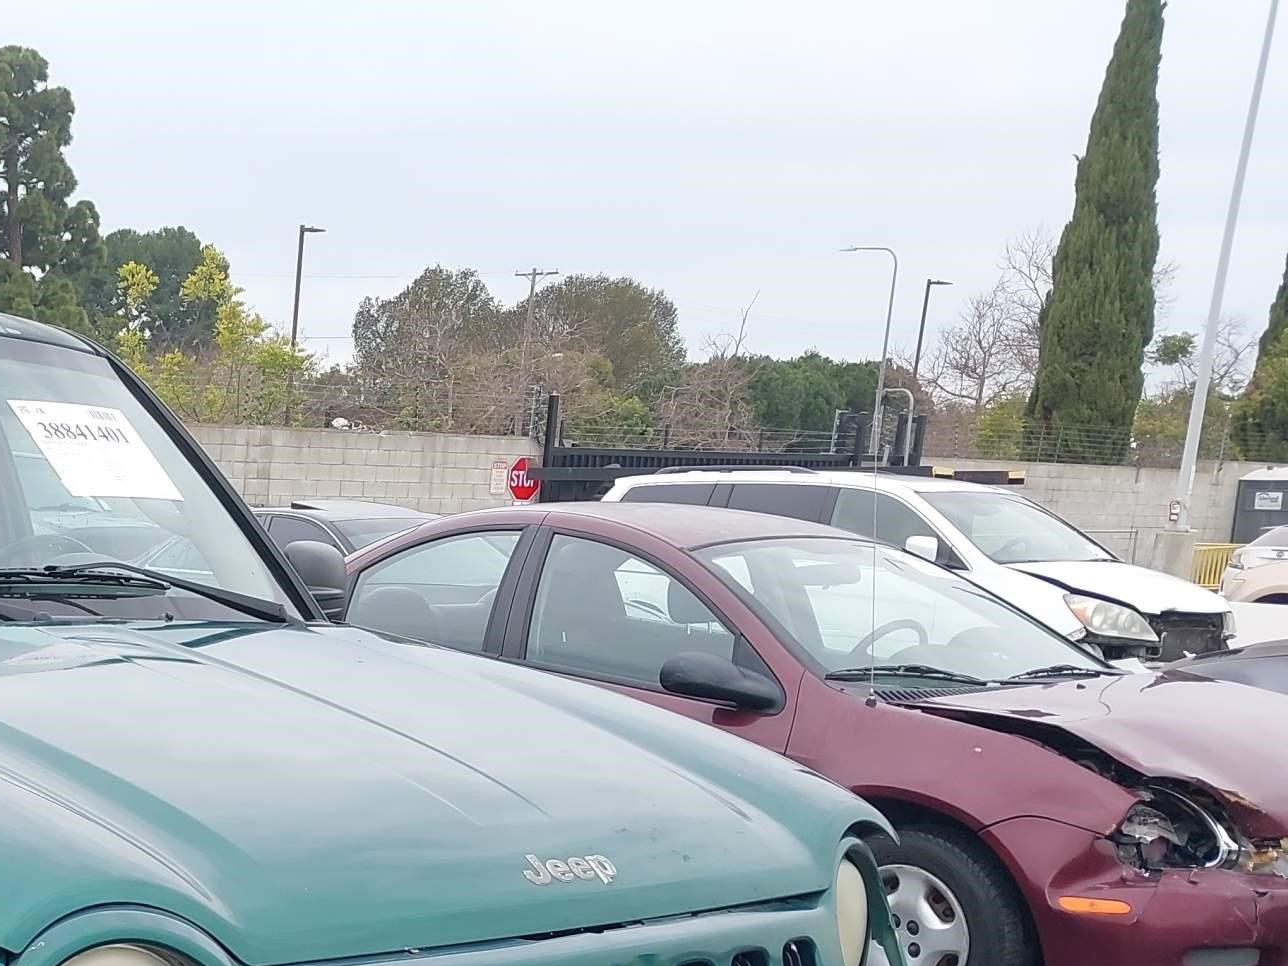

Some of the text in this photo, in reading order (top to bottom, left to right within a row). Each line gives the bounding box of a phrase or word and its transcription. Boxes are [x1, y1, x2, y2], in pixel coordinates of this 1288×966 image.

[37, 421, 130, 444] 38841401
[511, 470, 534, 487] STO
[522, 853, 617, 886] Jeep
